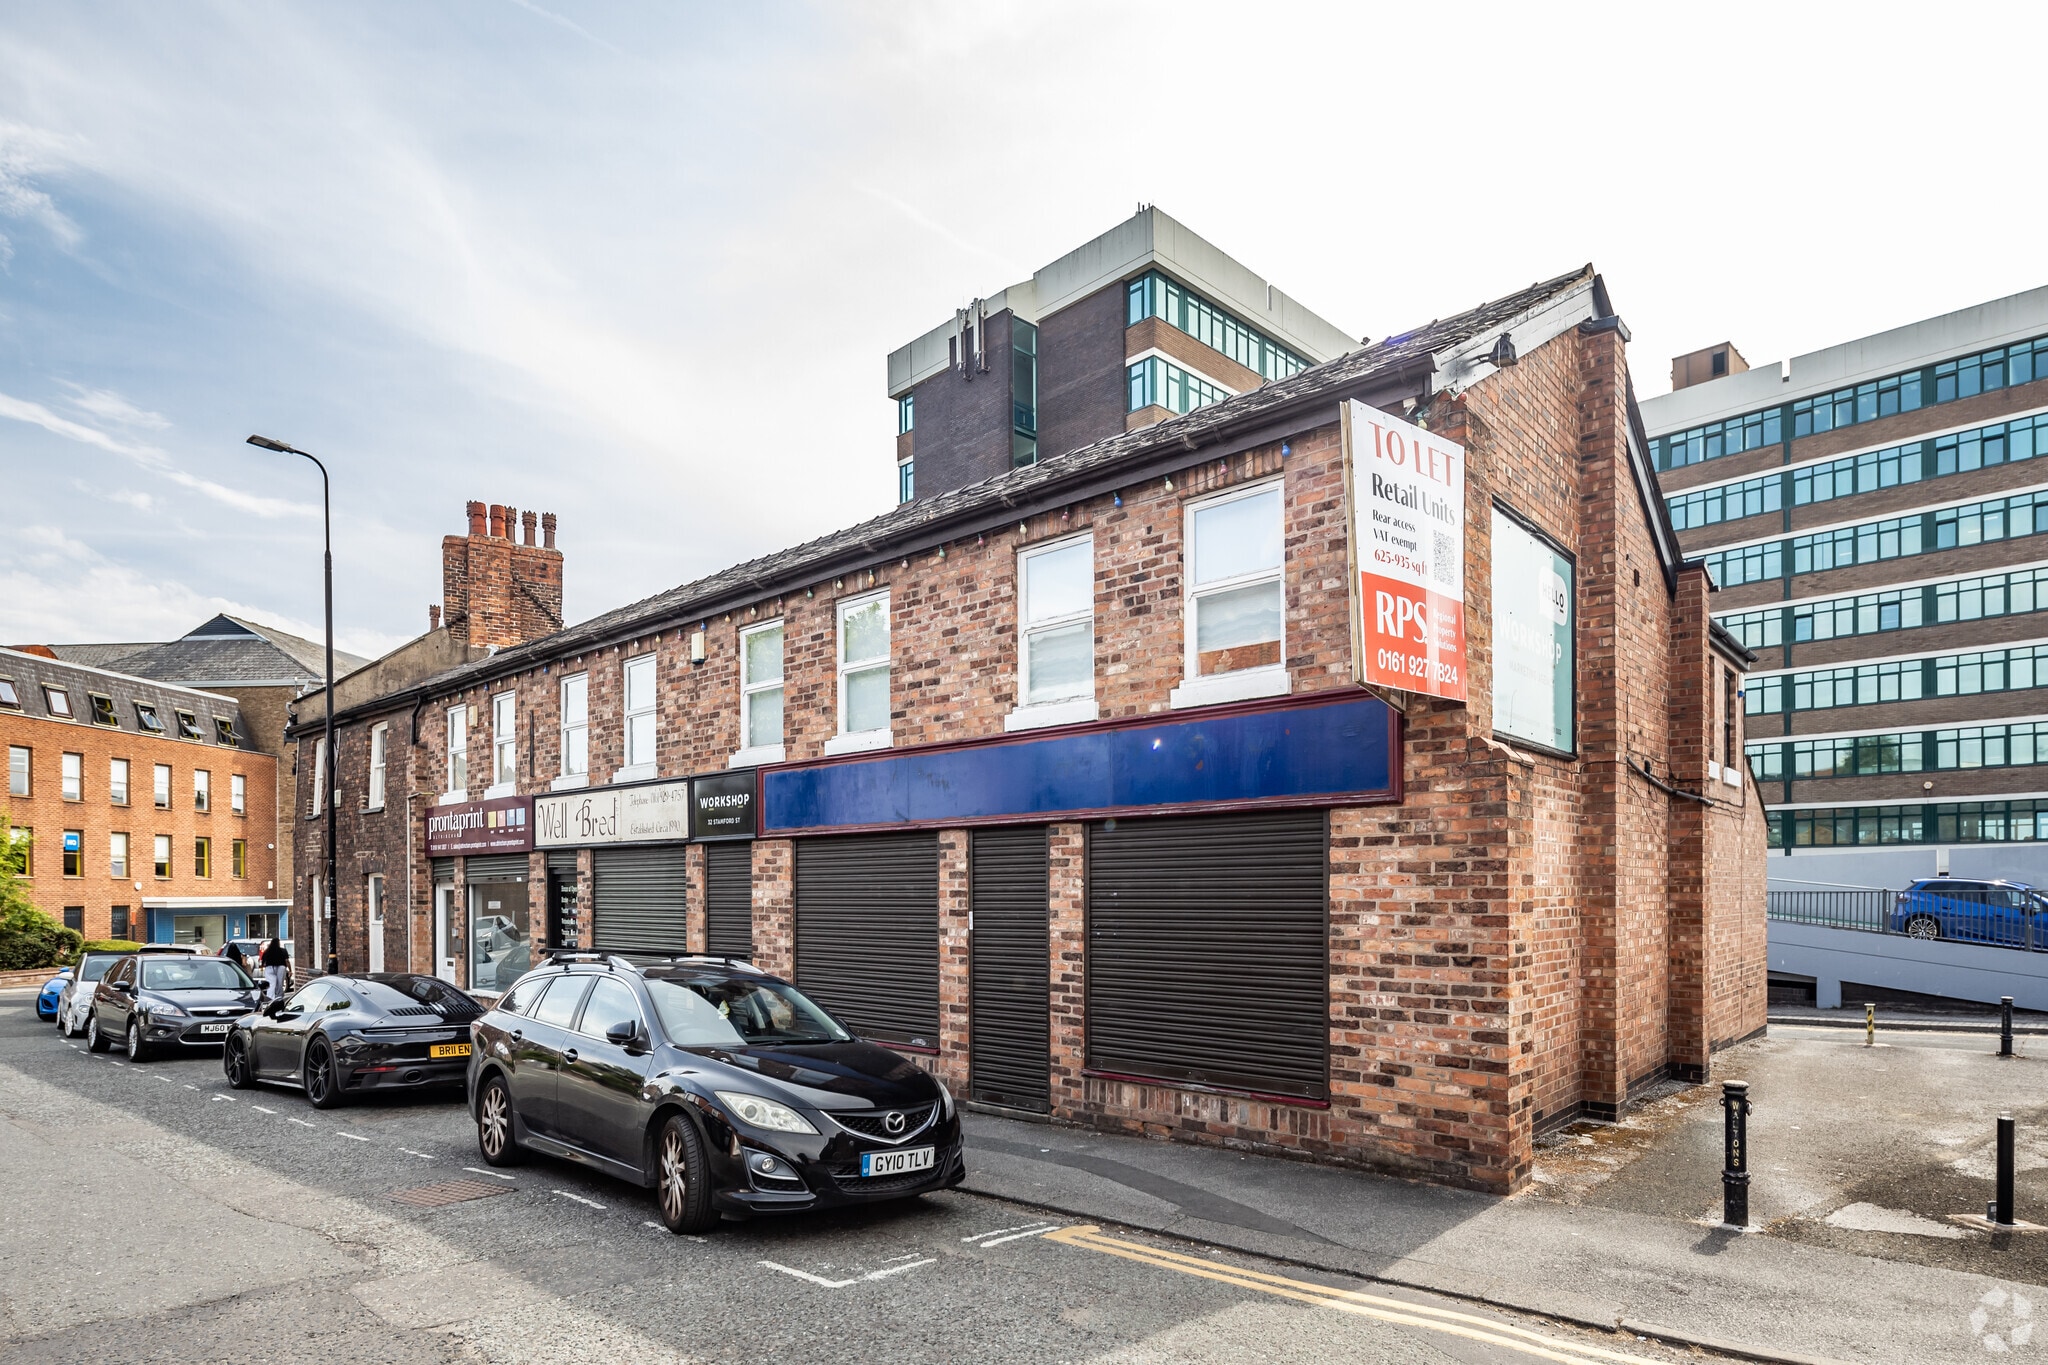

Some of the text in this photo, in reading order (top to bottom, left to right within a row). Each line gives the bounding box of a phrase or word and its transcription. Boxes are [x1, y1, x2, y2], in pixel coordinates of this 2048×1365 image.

[1367, 420, 1456, 487] TO LET
[1372, 472, 1456, 526] Retail Units
[1372, 509, 1416, 533] Rear access
[1373, 527, 1418, 553] VAT exempt
[1374, 548, 1410, 570] 625-935
[1411, 561, 1421, 577] sq
[1542, 582, 1565, 609] HELLO
[1498, 611, 1562, 665] WORKSHOP
[1377, 648, 1459, 685] 0161 927 7824
[699, 793, 750, 809] WORKSHOP
[428, 806, 485, 840] prontaprint
[538, 796, 617, 840] Well Bred
[713, 817, 735, 825] STAMFORD
[439, 1045, 472, 1055] BR11 EN
[1731, 1100, 1740, 1167] WALTONS
[875, 1150, 930, 1173] GY10 TLV
